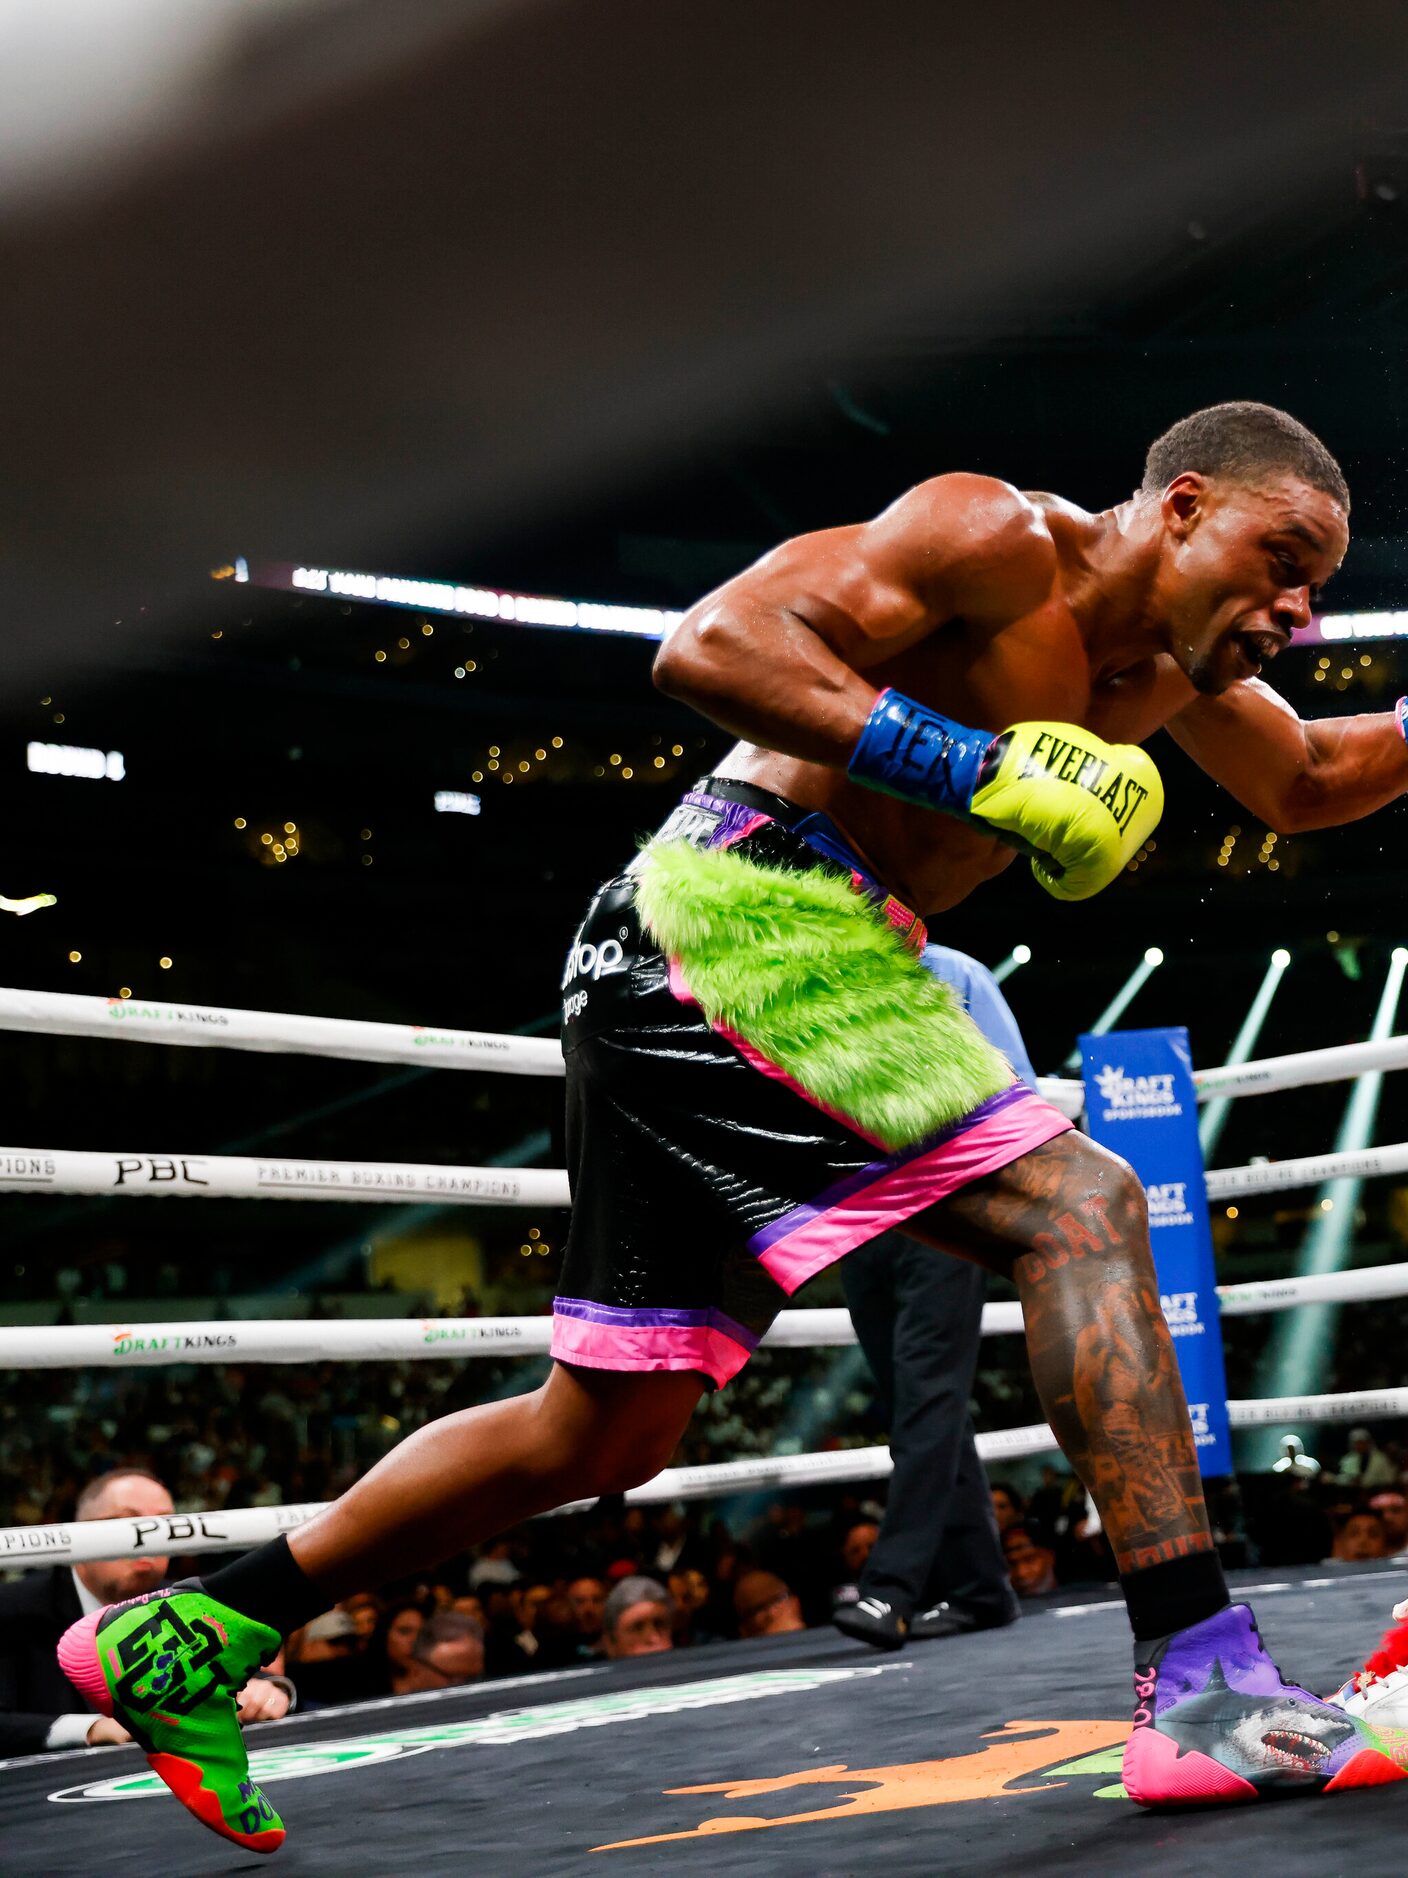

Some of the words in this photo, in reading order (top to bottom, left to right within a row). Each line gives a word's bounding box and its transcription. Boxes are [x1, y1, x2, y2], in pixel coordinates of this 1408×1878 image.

[1018, 731, 1148, 838] EVERLAST
[114, 1159, 209, 1185] PBC
[113, 1334, 237, 1356] DRAFTKINGS
[133, 1514, 229, 1548] PBC
